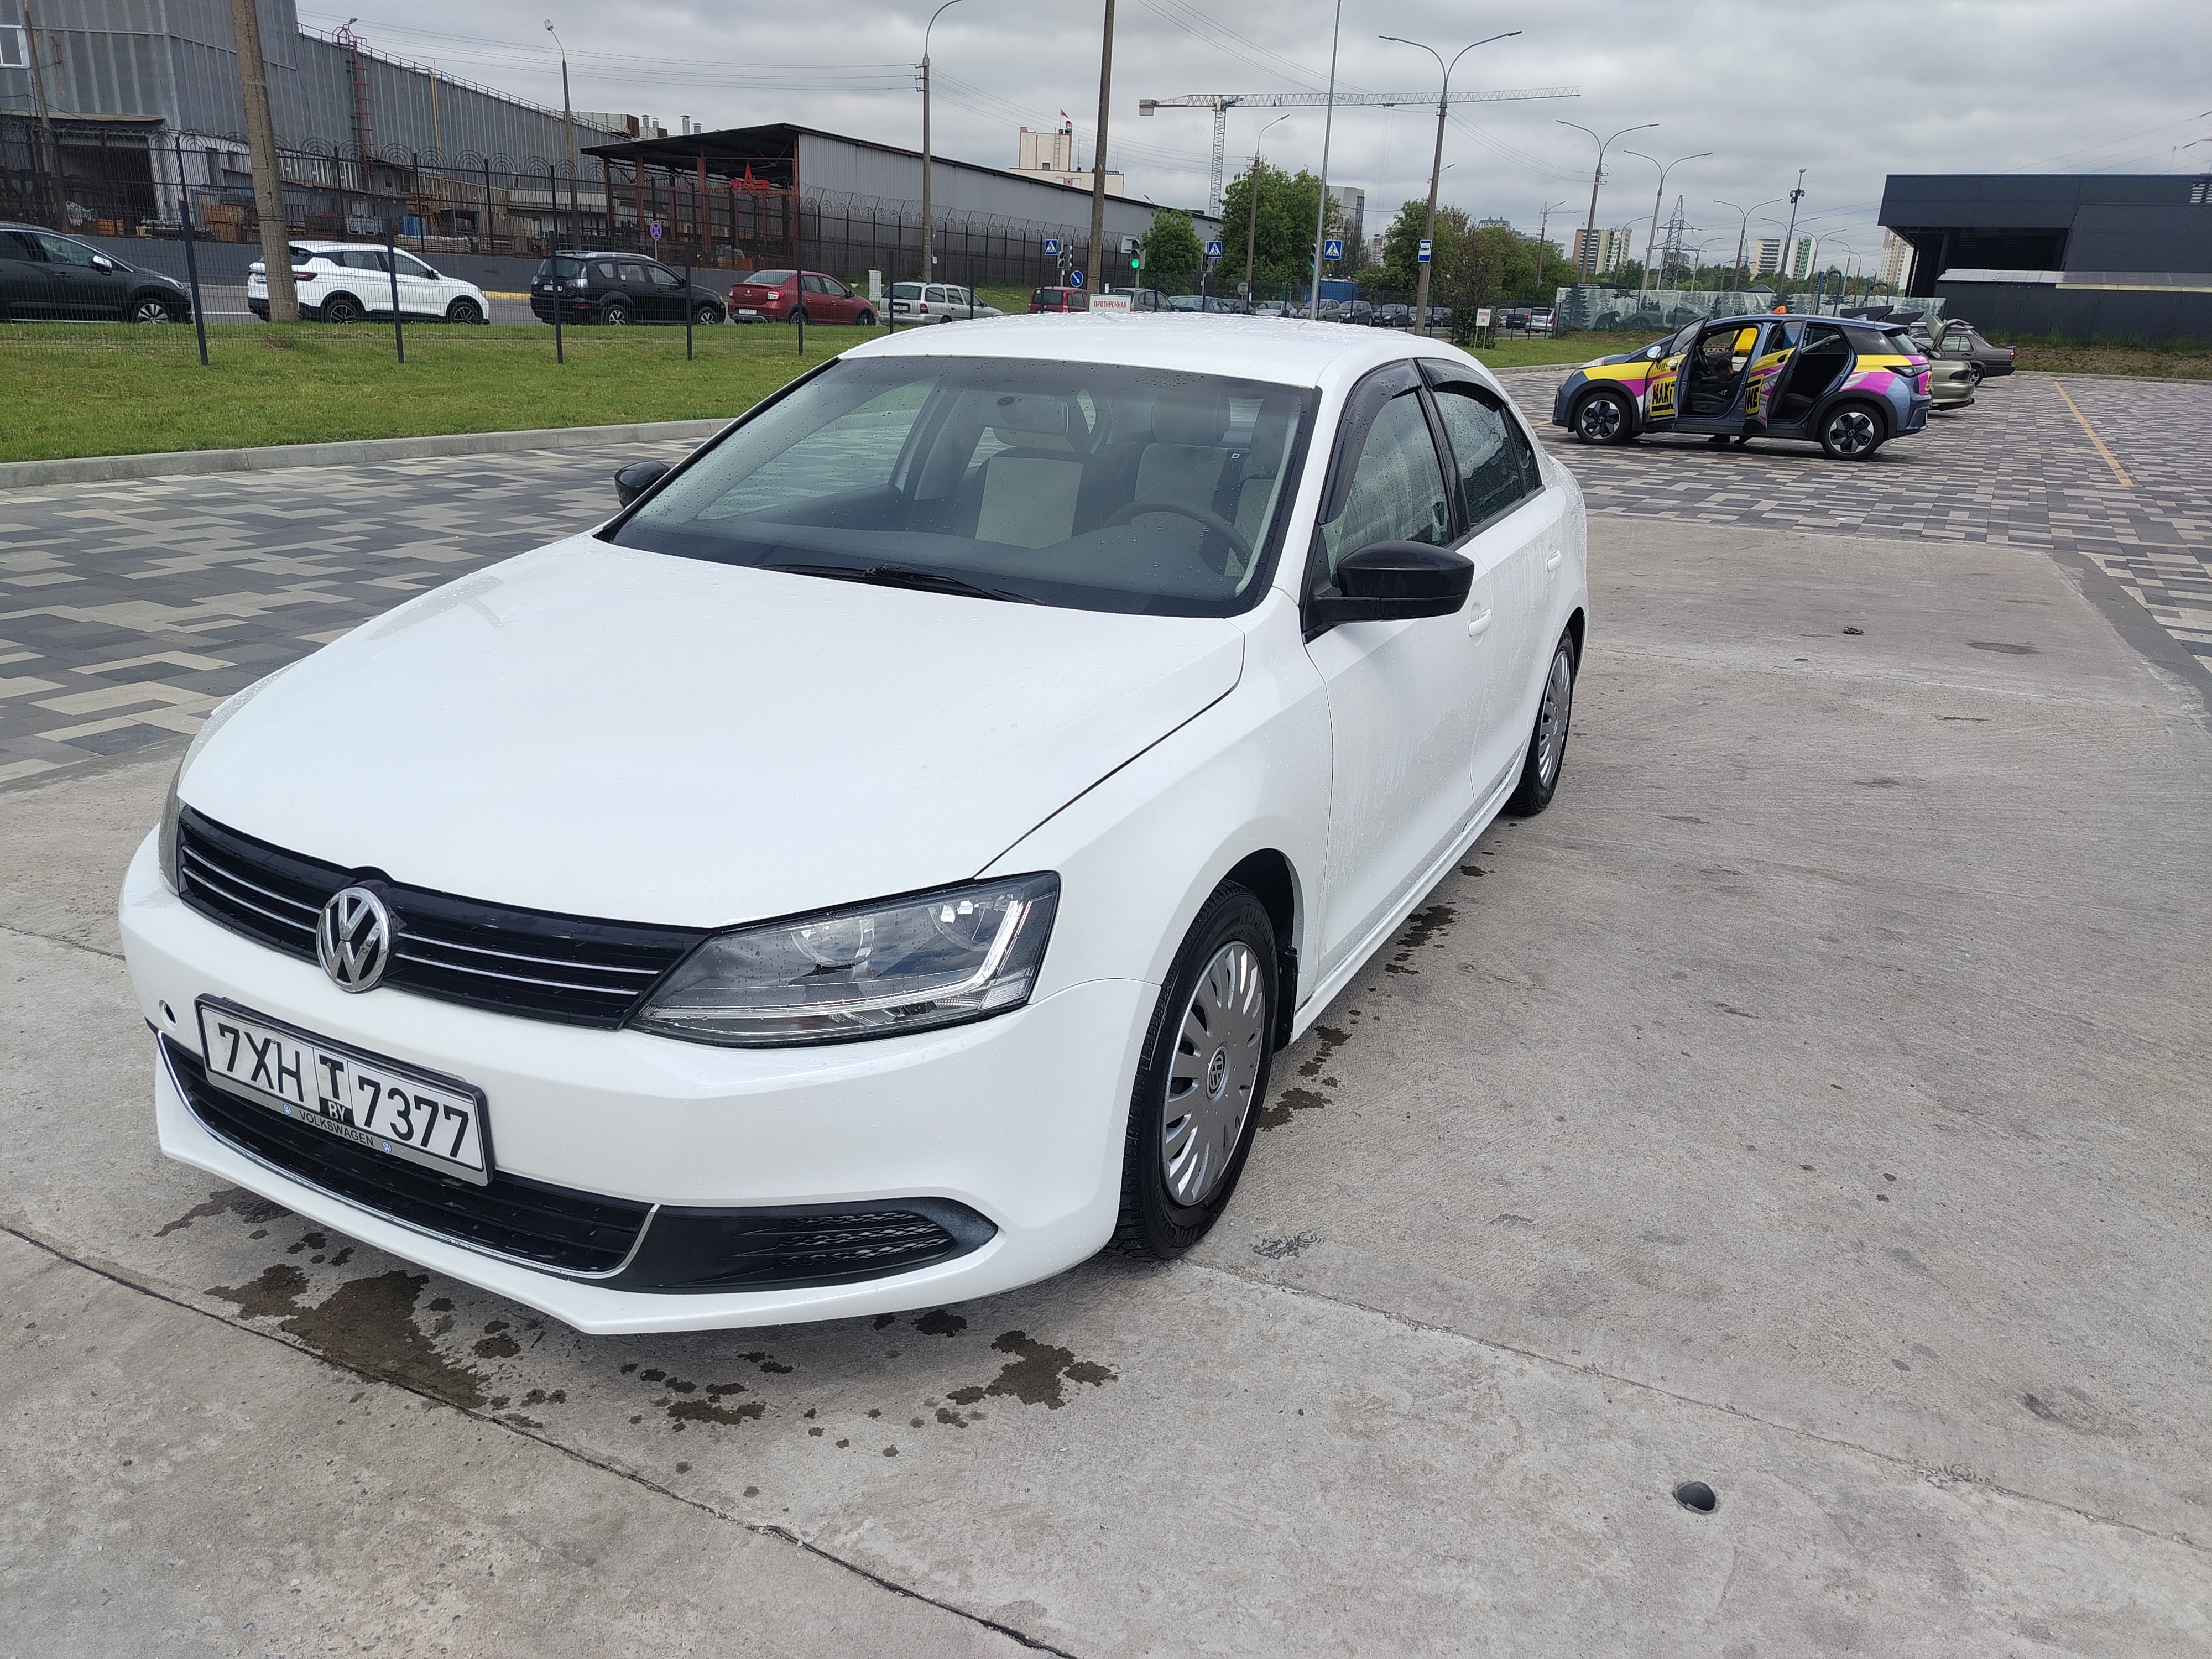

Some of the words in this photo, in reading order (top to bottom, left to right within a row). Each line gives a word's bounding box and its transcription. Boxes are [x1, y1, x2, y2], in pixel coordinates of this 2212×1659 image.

[1094, 300, 1127, 309] ПРОТИРОЧНАЯ
[217, 1021, 305, 1103] 7XH
[319, 1053, 345, 1100] T
[358, 1074, 469, 1158] 7377
[328, 1100, 346, 1122] BY
[299, 1109, 374, 1147] VOLKSWAGEN
